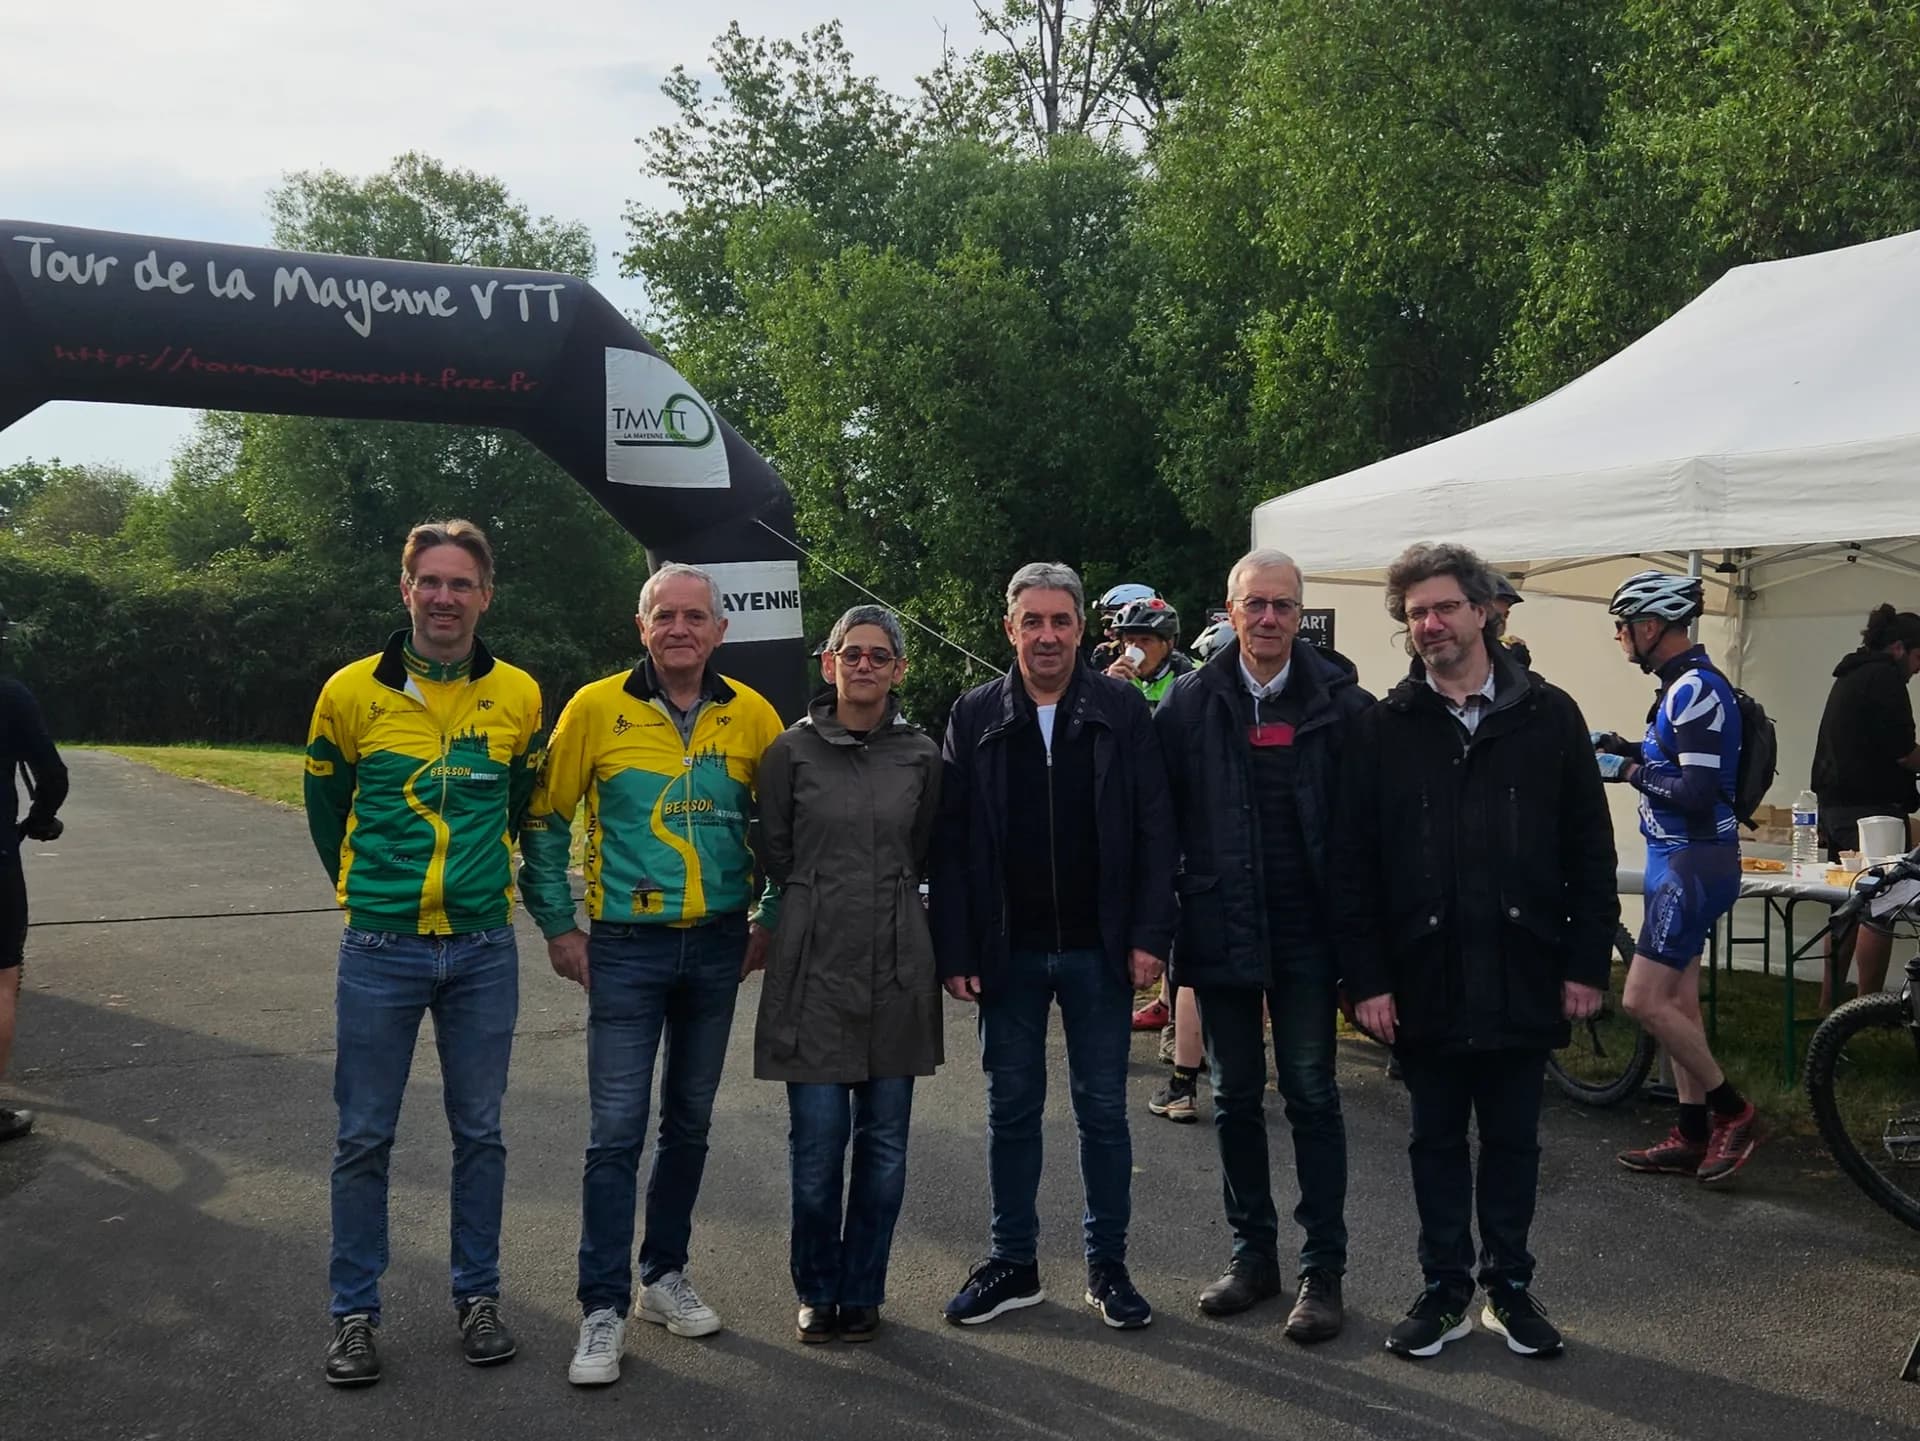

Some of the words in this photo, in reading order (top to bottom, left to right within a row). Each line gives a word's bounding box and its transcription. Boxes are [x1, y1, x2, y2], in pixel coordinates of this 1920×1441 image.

[13, 235, 118, 285] Tour
[134, 250, 194, 295] de
[207, 260, 256, 301] la
[273, 266, 459, 338] Mayenne
[470, 280, 566, 323] VTT
[722, 590, 799, 612] AYENNE
[1299, 615, 1328, 630] ART
[430, 766, 472, 777] BERSON
[664, 799, 713, 815] BERSON
